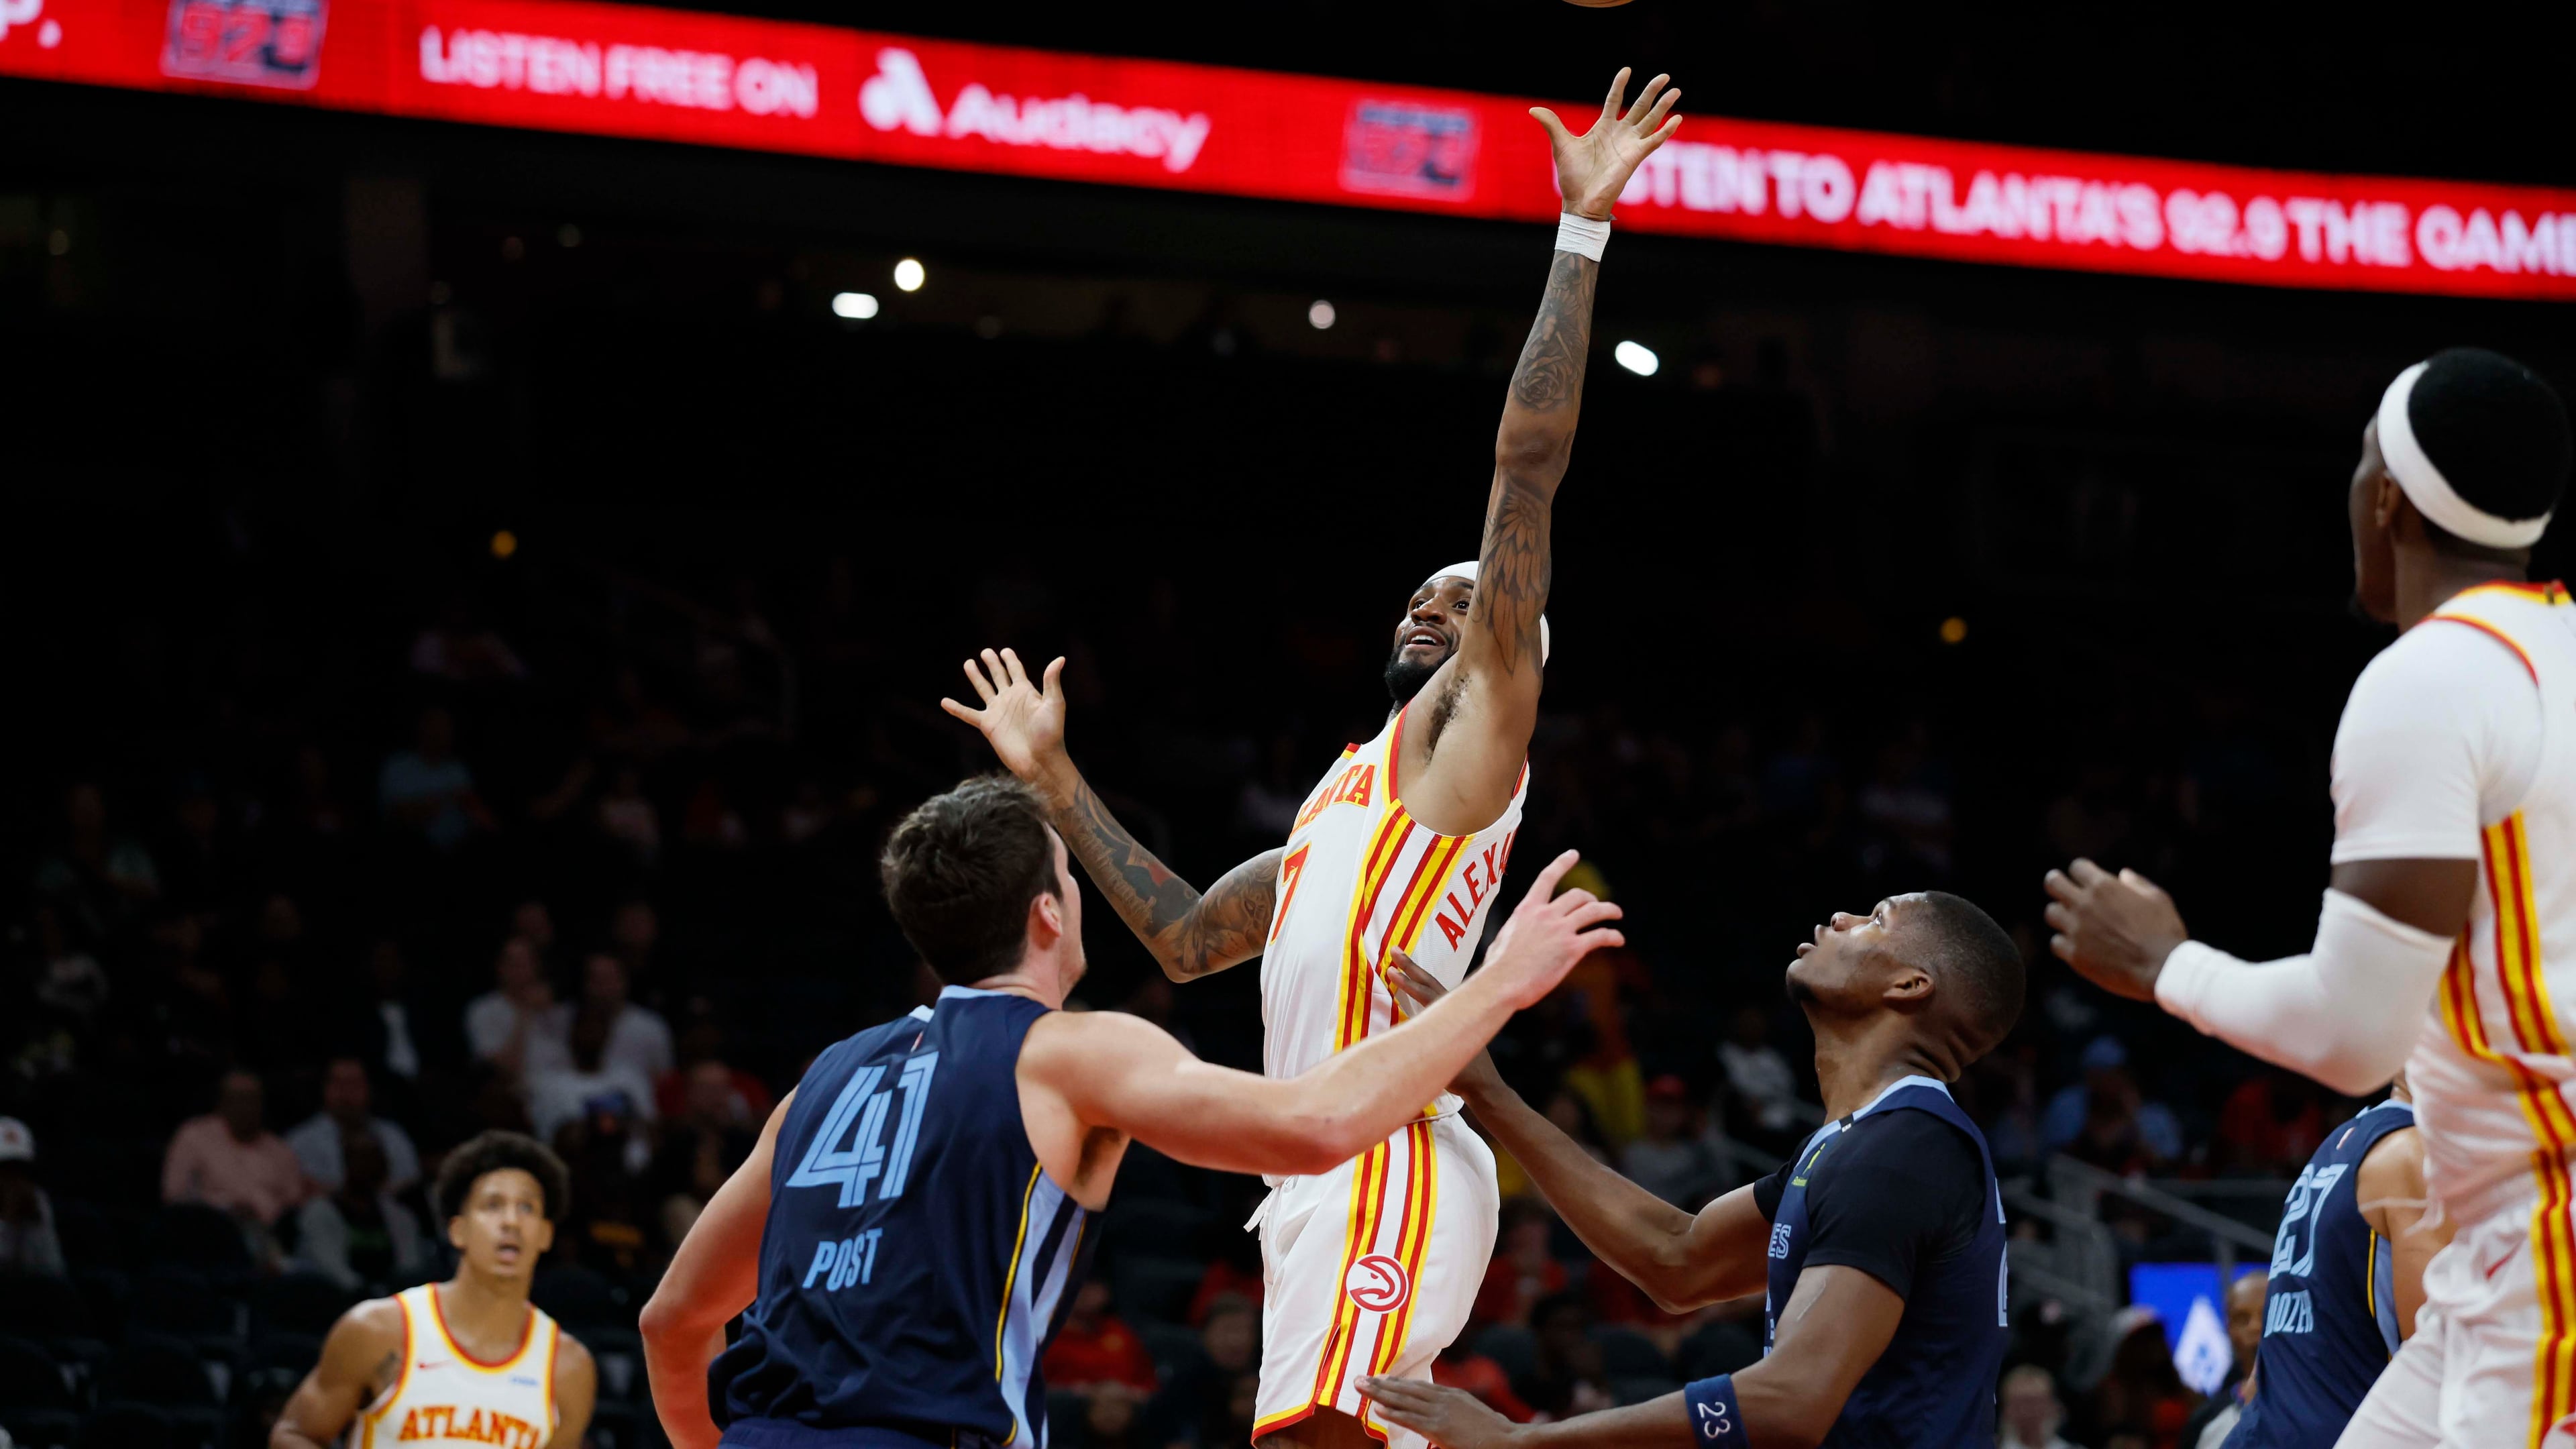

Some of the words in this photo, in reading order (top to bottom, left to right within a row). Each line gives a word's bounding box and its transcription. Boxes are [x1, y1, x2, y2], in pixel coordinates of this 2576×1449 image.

[420, 25, 602, 98] LISTEN
[605, 44, 734, 111] FREE
[735, 58, 818, 119] ON
[945, 82, 1210, 173] Audacy
[1766, 149, 1856, 223] TO
[1857, 158, 2164, 252] ATLANTA'S
[2284, 196, 2414, 268] THE
[1269, 841, 1311, 947] 7
[785, 1051, 939, 1208] 41
[802, 1228, 883, 1293] POST
[2267, 1163, 2349, 1281] 27
[1697, 1401, 1731, 1439] 23
